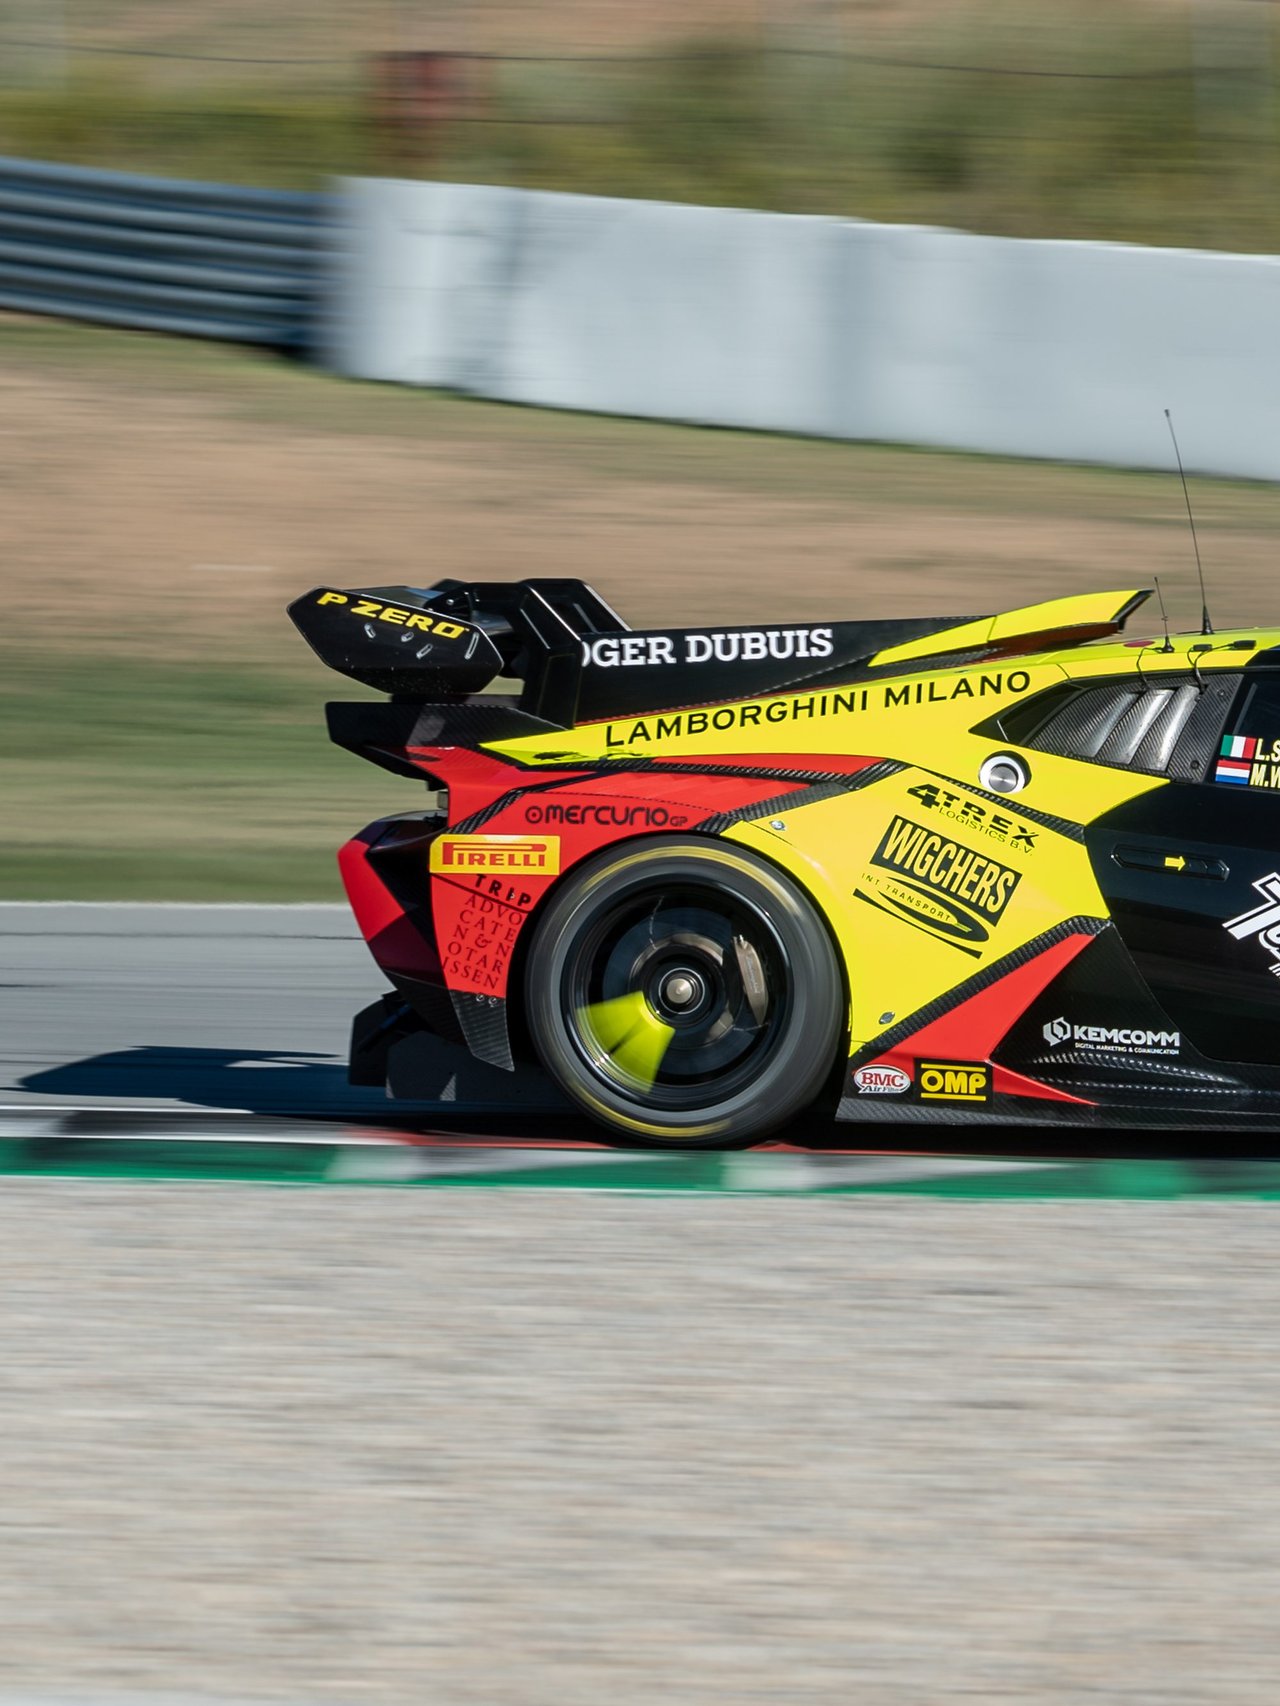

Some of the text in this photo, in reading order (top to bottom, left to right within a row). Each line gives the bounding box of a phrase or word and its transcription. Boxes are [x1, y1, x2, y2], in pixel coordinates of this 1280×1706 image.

[317, 592, 465, 639] P ZERO
[685, 628, 834, 663] DUBUIS
[606, 671, 1031, 747] LAMBORGHINI MILANO
[939, 807, 1033, 856] LOGISTICS B.V.
[442, 842, 547, 867] PIRELLI
[882, 818, 1016, 914] WIGCHERS
[475, 873, 532, 906] TRIP
[885, 884, 951, 921] TRANSPORT
[460, 909, 516, 942] CATE
[465, 894, 522, 925] ADVO
[442, 956, 499, 989] ISSEN
[448, 941, 503, 974] OTAR
[1073, 1025, 1180, 1047] KEMCOMM
[1096, 1044, 1127, 1053] MARKETING
[862, 1072, 904, 1087] BMC
[921, 1070, 987, 1094] OMP
